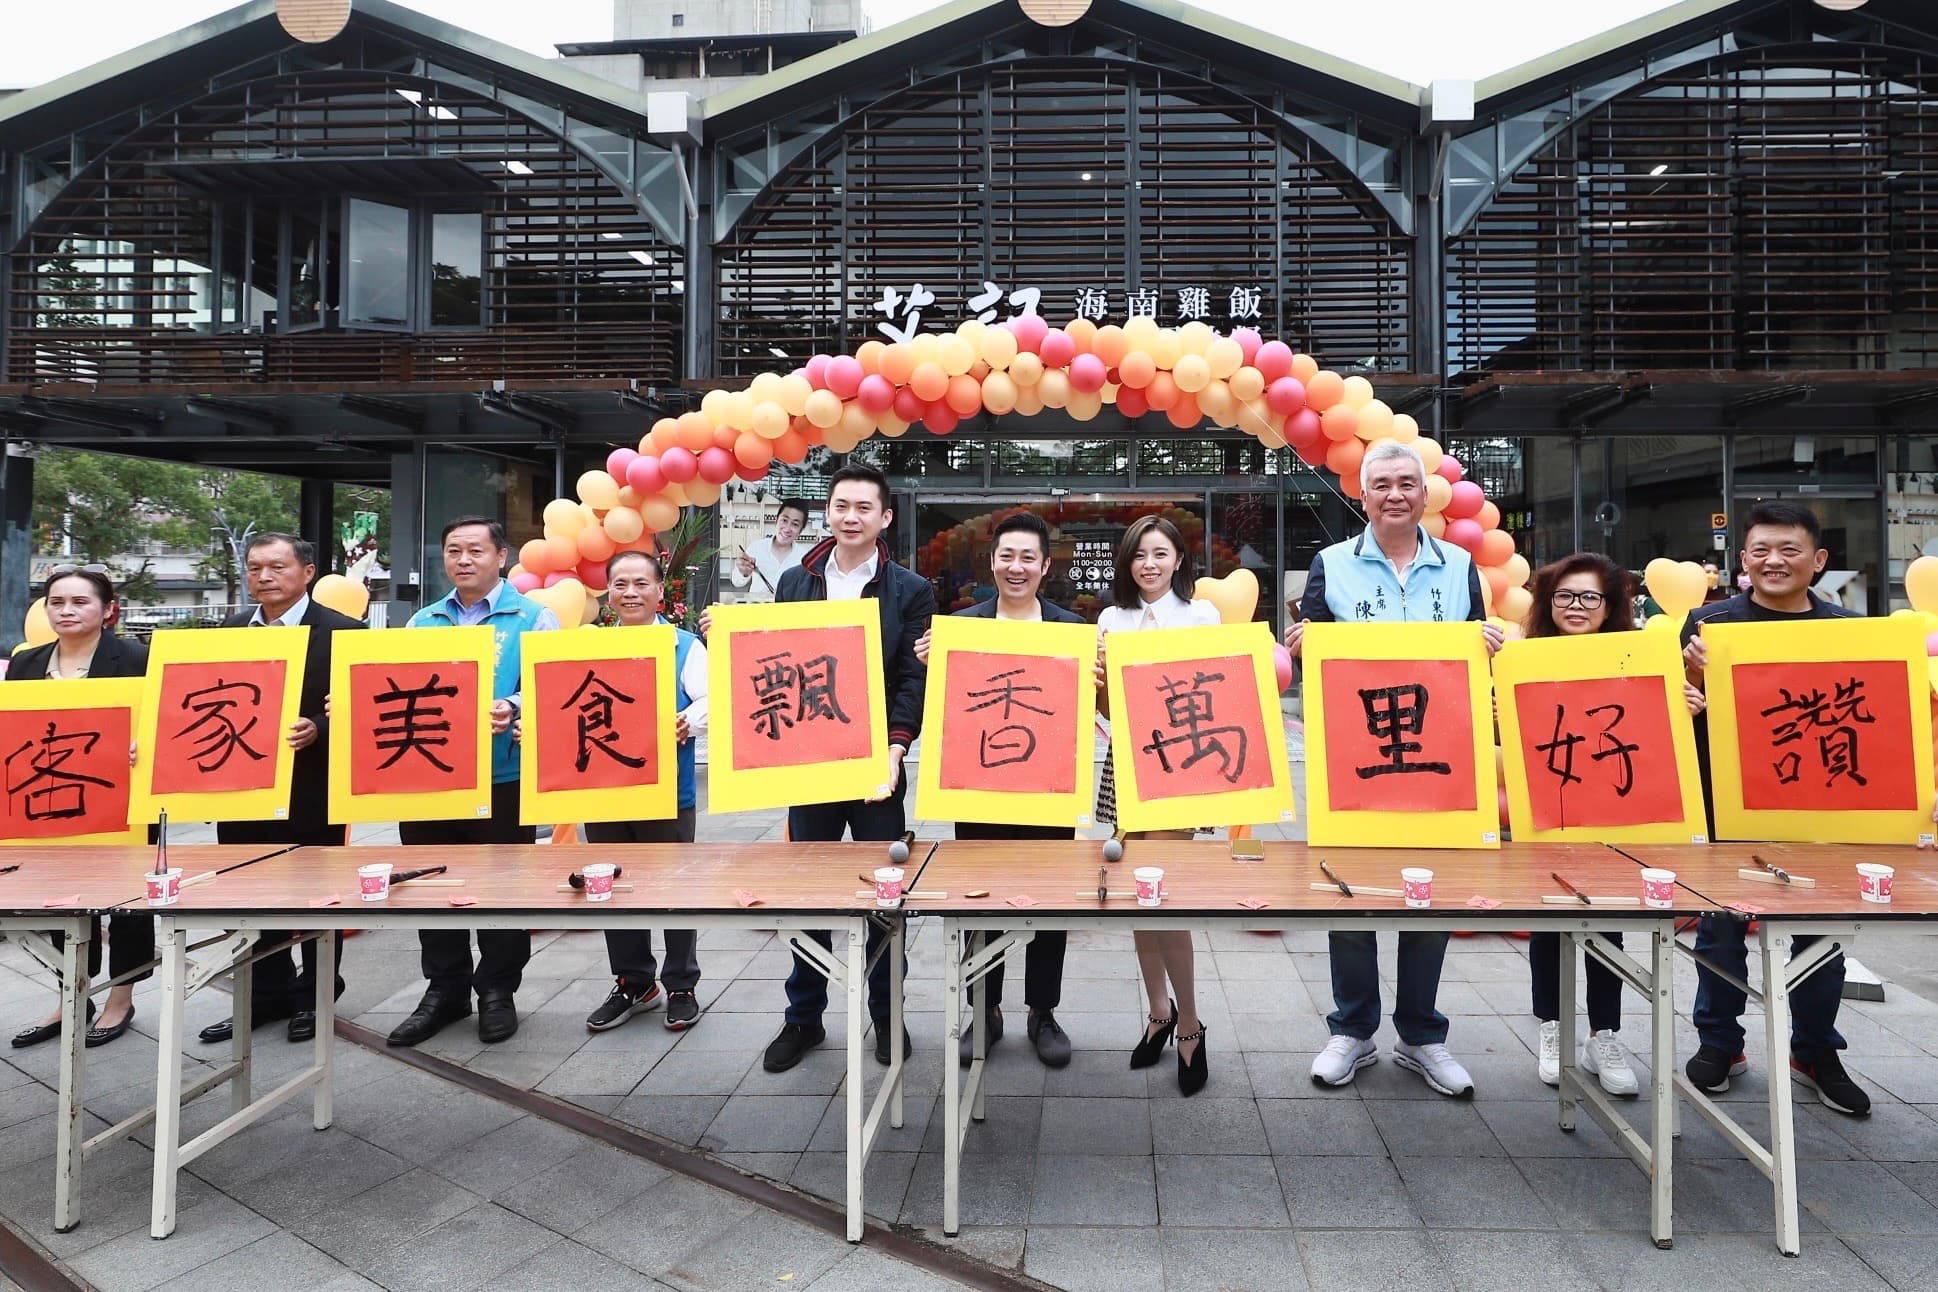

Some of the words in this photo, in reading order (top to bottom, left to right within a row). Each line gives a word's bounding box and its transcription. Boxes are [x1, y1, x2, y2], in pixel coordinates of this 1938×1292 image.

[1075, 286, 1262, 320] 海南雞飯
[1376, 585, 1386, 611] 主席
[173, 678, 267, 773] 家
[372, 673, 459, 773] 美
[561, 669, 647, 773] 食
[749, 651, 851, 740] 飄
[965, 668, 1054, 768] 香
[1143, 671, 1247, 783] 萬
[1355, 683, 1452, 779] 里
[1760, 677, 1876, 788] 讚
[5, 721, 115, 821] 客
[1534, 704, 1639, 800] 好
